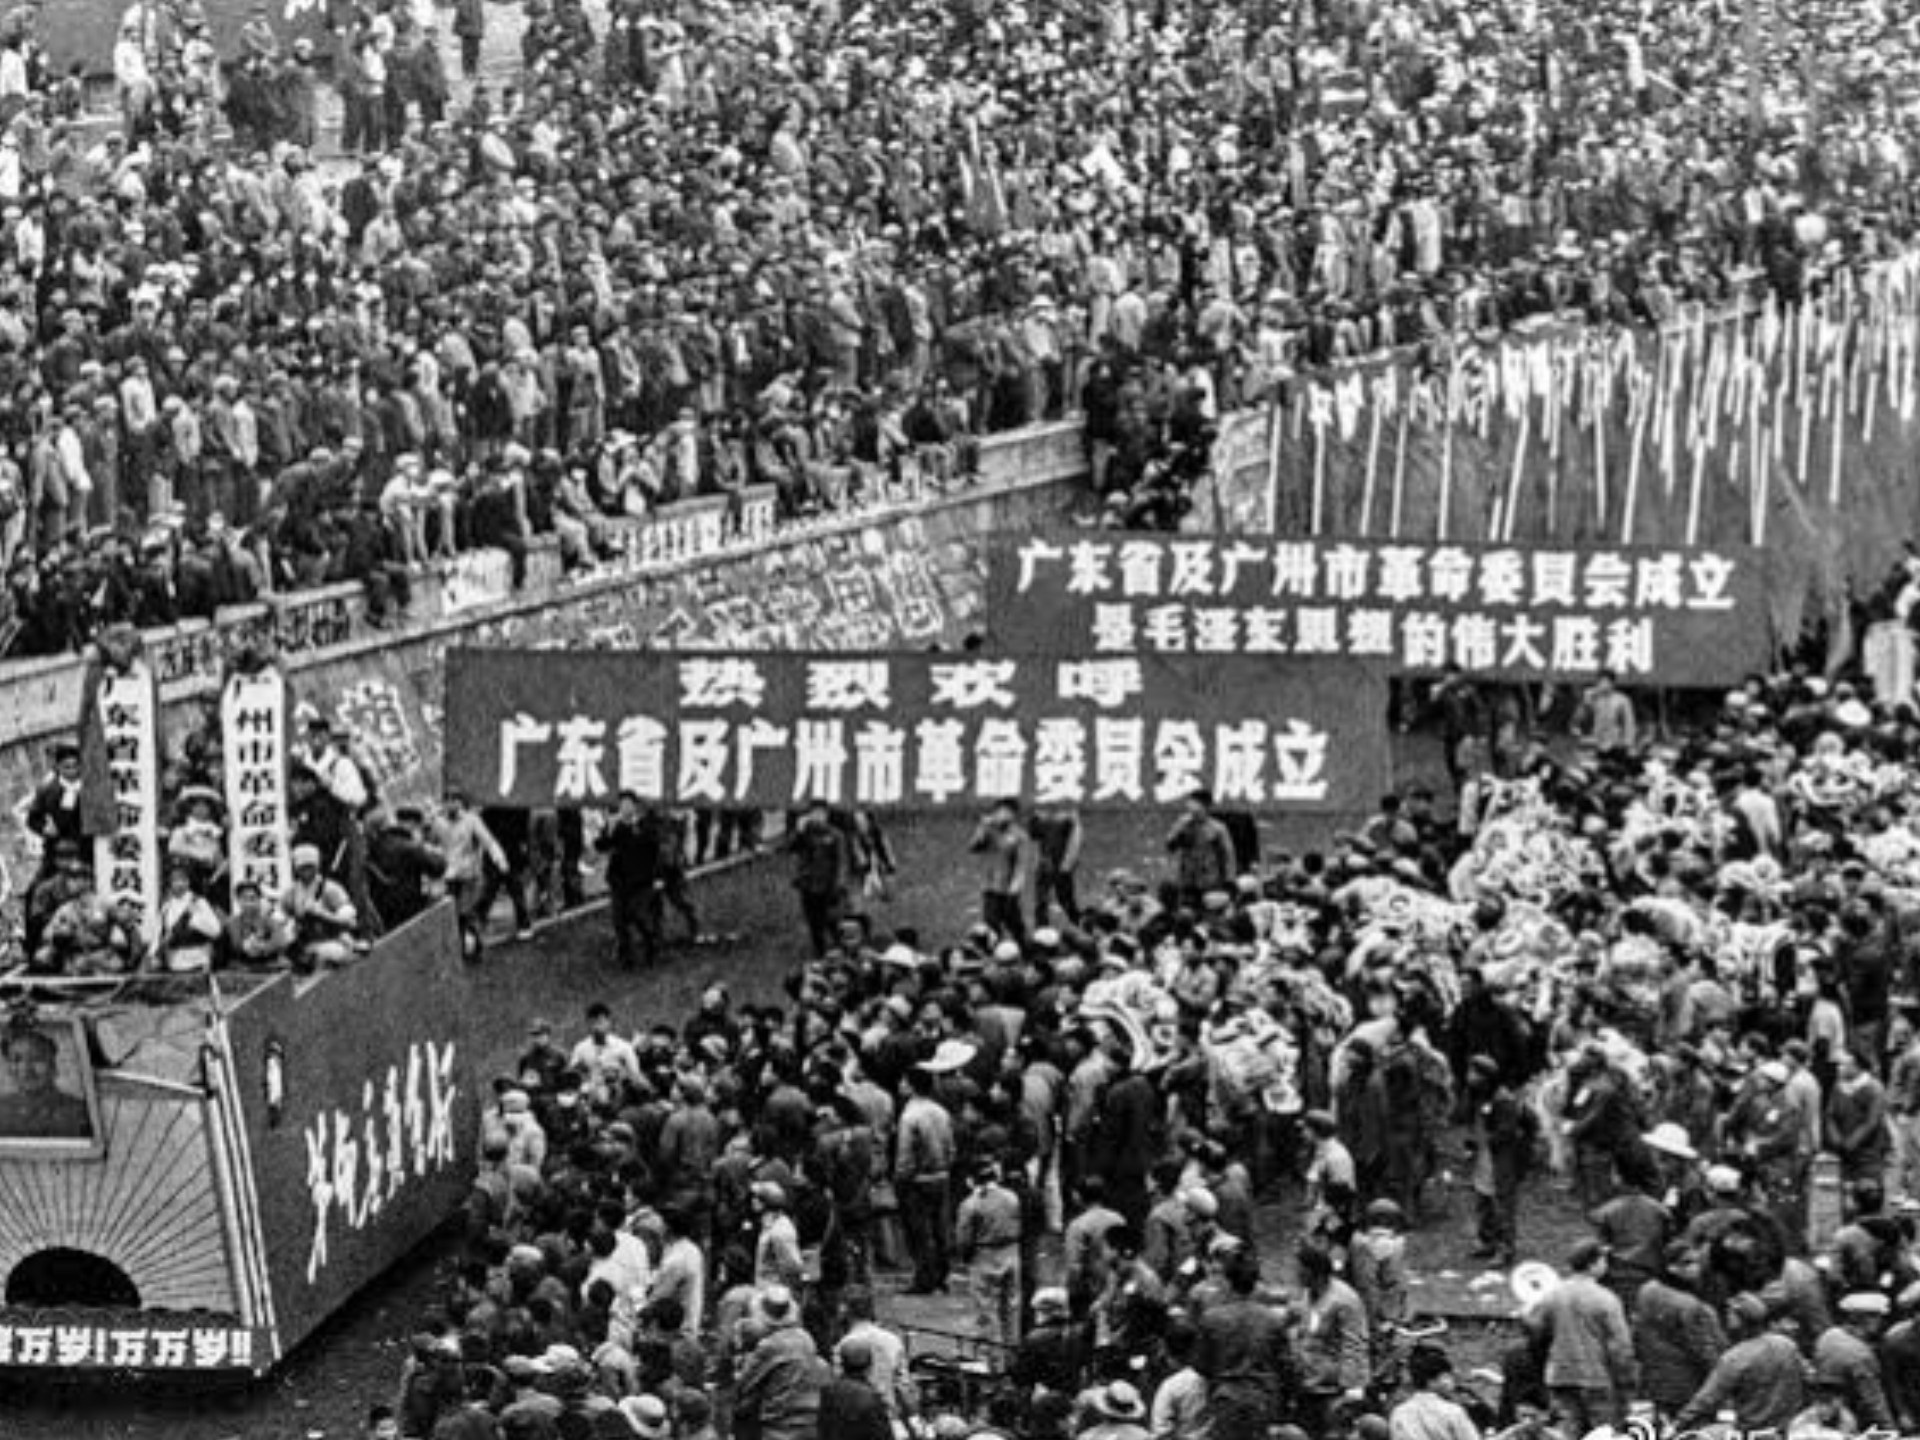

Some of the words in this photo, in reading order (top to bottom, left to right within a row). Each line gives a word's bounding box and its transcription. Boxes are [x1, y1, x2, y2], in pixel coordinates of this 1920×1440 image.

[679, 658, 1143, 708] 热烈欢呼
[498, 713, 1329, 803] 广东省及广州市革命委员会成立
